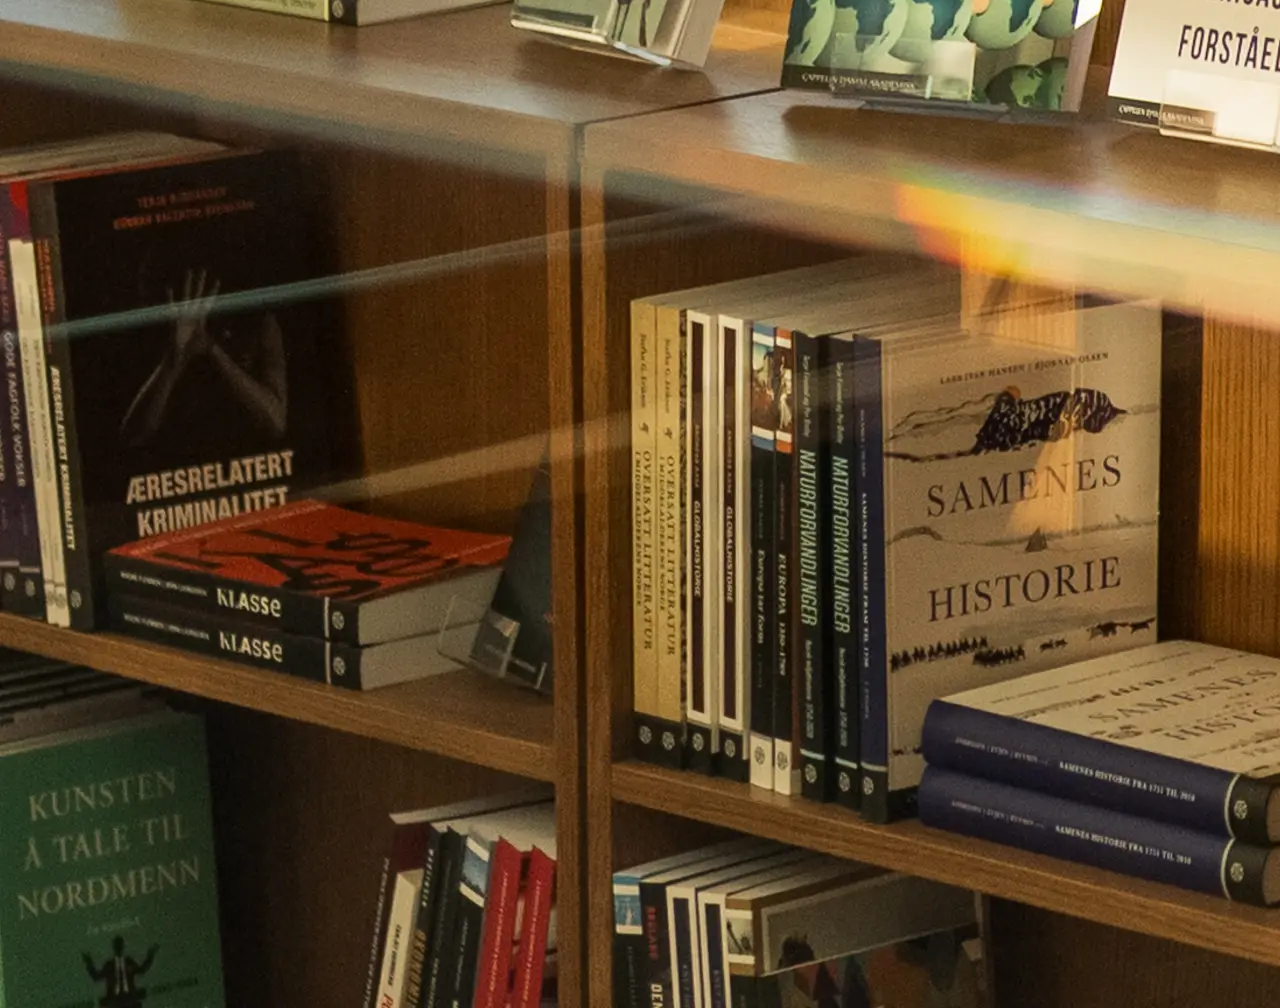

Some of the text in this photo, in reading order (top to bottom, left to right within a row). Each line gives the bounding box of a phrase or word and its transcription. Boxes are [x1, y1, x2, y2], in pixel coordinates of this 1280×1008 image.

[50, 365, 77, 551] ÆRESRELATERT KRIMINALITET
[126, 449, 295, 505] ÆRESRELATERT
[927, 455, 1122, 519] SAMENES
[136, 486, 289, 539] KRIMINALITET
[799, 449, 817, 627] NATURFORVANDLINGER
[832, 456, 850, 634] NATURFORVANDLINGER
[641, 451, 653, 651] OVERSATT LITTERATUR
[665, 456, 676, 656] OVERSATT LITTERATUR
[692, 500, 702, 598] GLOBALHISTORIE
[725, 505, 735, 604] GLOBALHISTORIE
[755, 549, 766, 644] Europa tar form
[776, 553, 787, 615] EUROPA
[927, 555, 1122, 623] HISTORIE
[1088, 667, 1277, 724] SAMENES
[29, 766, 178, 822] KUNSTEN
[1132, 777, 1148, 792] FRA
[24, 813, 191, 872] Å TALE TIL
[1128, 842, 1144, 856] FRA
[17, 855, 200, 920] NORDMENN
